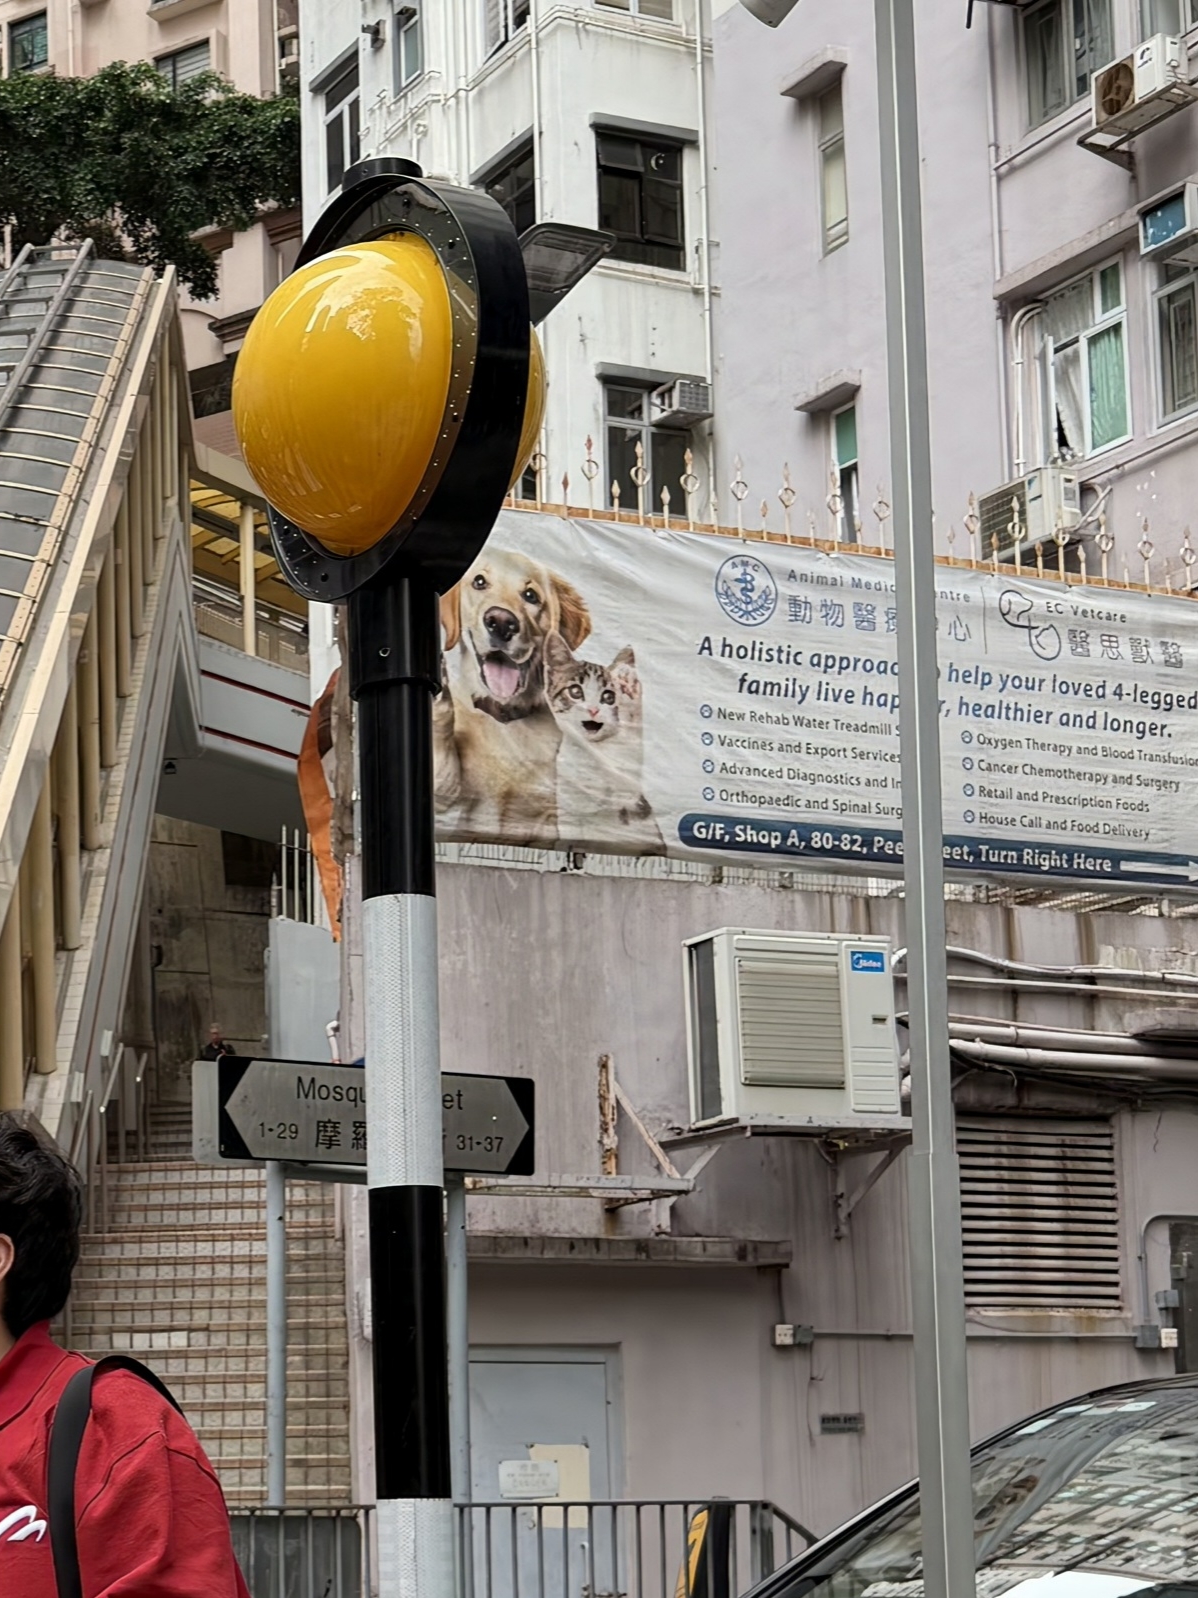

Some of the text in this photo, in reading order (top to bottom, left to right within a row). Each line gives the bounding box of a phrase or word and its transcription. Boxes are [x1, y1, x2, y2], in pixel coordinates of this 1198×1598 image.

[787, 569, 971, 603] Animal Medic ntre
[1046, 602, 1127, 623] EC Vetcare
[697, 636, 1198, 711] A holistic approac help your loved 4-legged
[738, 672, 810, 705] family
[816, 681, 855, 704] live
[958, 696, 1053, 725] healthier
[1059, 710, 1097, 730] and
[1103, 711, 1173, 740] longer.
[717, 707, 746, 722] New
[749, 710, 790, 726] Rehab
[792, 714, 830, 730] Water
[832, 718, 892, 736] Treadmill
[718, 734, 774, 752] Vaccines
[777, 741, 802, 754] and
[805, 743, 847, 760] Export
[976, 733, 1022, 750] Oxygen
[1025, 738, 1073, 757] Therapy
[1076, 744, 1098, 757] and
[1101, 745, 1134, 760] Blood
[719, 762, 783, 779] Advanced
[787, 768, 861, 786] Diagnostics
[864, 775, 888, 788] and
[978, 759, 1180, 793] Cancer Chemotherapy and Surgery
[719, 789, 903, 820] Orthopaedic and Spinal Surg
[979, 786, 1150, 813] Retail and Prescription Foods
[979, 812, 1150, 841] House Call and Food Delivery
[693, 821, 1112, 872] G/F, Shop A, 80-82, Pee eet, Turn Right Here
[296, 1076, 366, 1107] Mosqu
[258, 1121, 299, 1140] 1-29
[456, 1133, 504, 1153] 31-37
